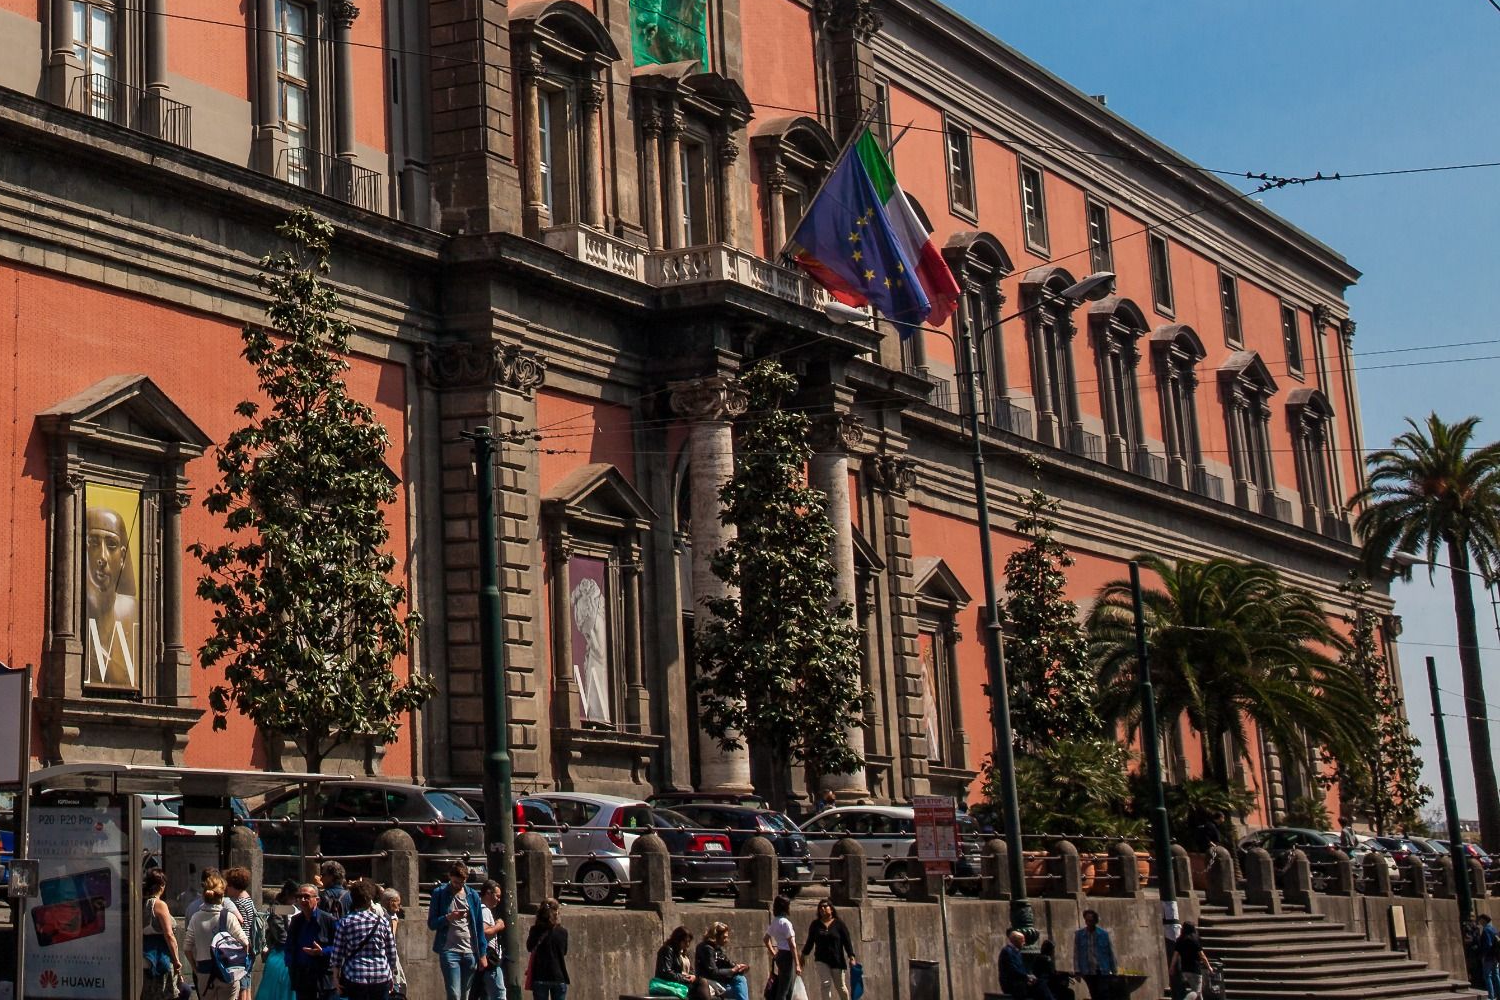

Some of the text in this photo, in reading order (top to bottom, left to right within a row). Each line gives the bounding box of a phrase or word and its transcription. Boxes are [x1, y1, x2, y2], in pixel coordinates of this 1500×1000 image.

[38, 814, 94, 825] P20 P20 Pro
[61, 976, 105, 988] HUAWEI
